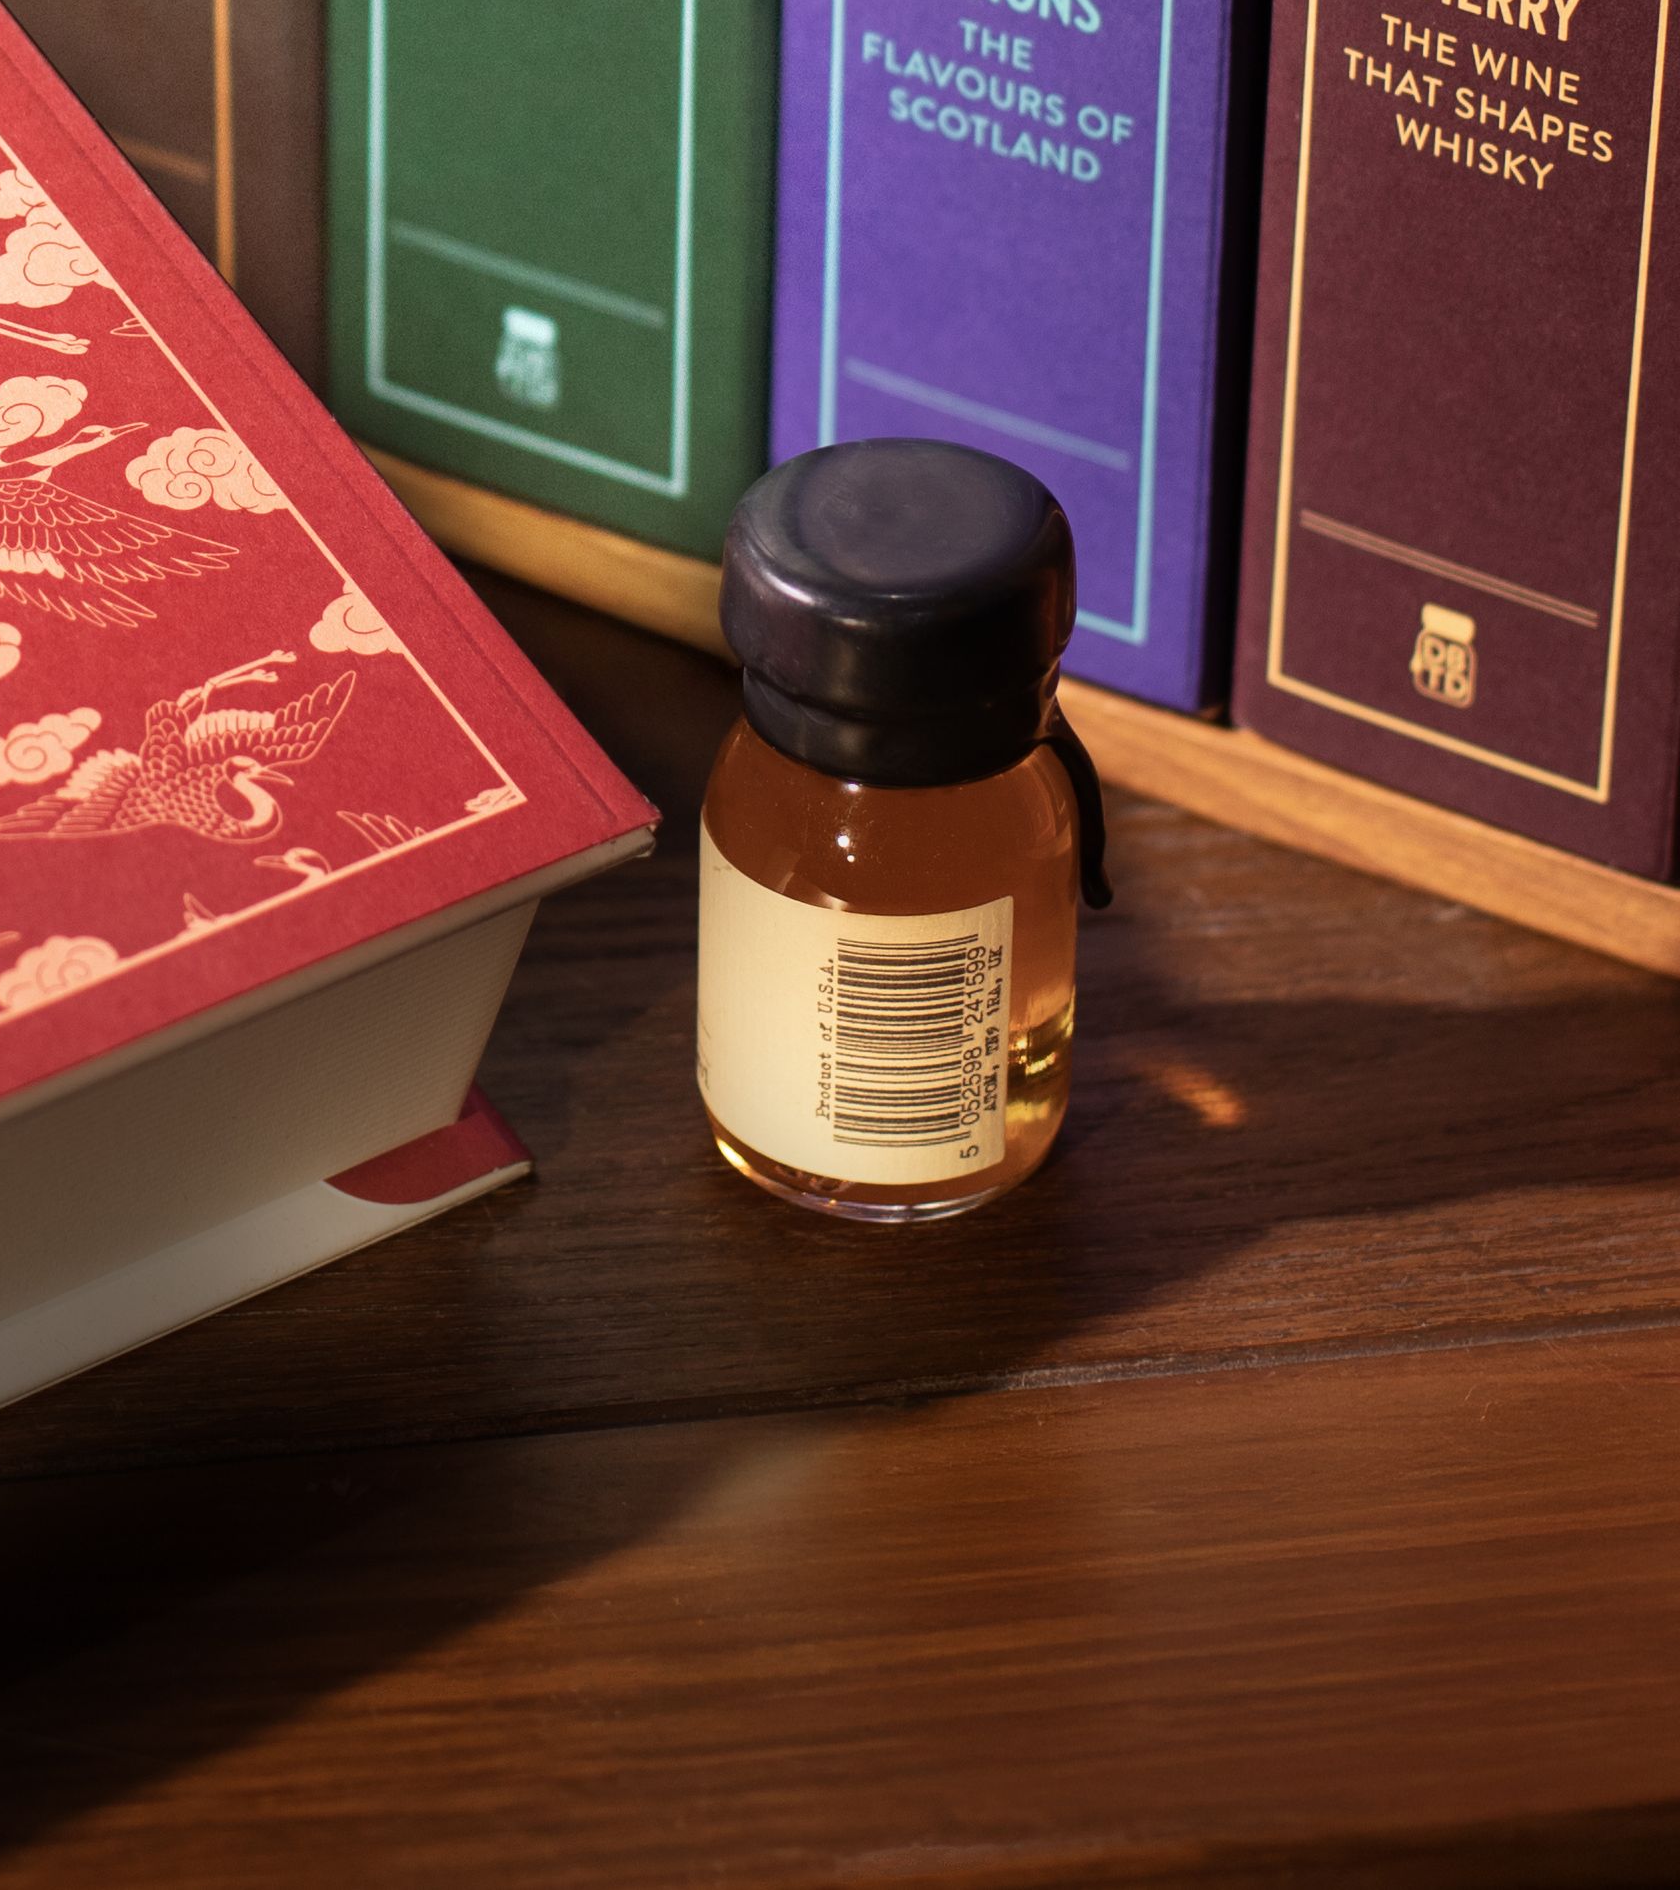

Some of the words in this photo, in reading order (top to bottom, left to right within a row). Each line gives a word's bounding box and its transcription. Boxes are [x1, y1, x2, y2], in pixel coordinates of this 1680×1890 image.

[958, 19, 1035, 72] THE
[1381, 14, 1456, 66] THE
[1471, 39, 1581, 105] WINE
[861, 33, 1067, 128] FLAVOURS
[1076, 103, 1134, 147] OF
[1343, 48, 1444, 108] THAT
[1455, 86, 1613, 164] SHAPES
[888, 87, 1101, 184] SCOTLAND
[1394, 113, 1556, 190] WHISKY
[817, 958, 835, 1015] U.S.A.
[964, 945, 986, 1028] 241599
[987, 944, 1003, 970] UK
[820, 1021, 834, 1043] of
[815, 1051, 832, 1120] Product
[960, 1046, 983, 1126] 052598
[960, 1144, 979, 1159] 5
